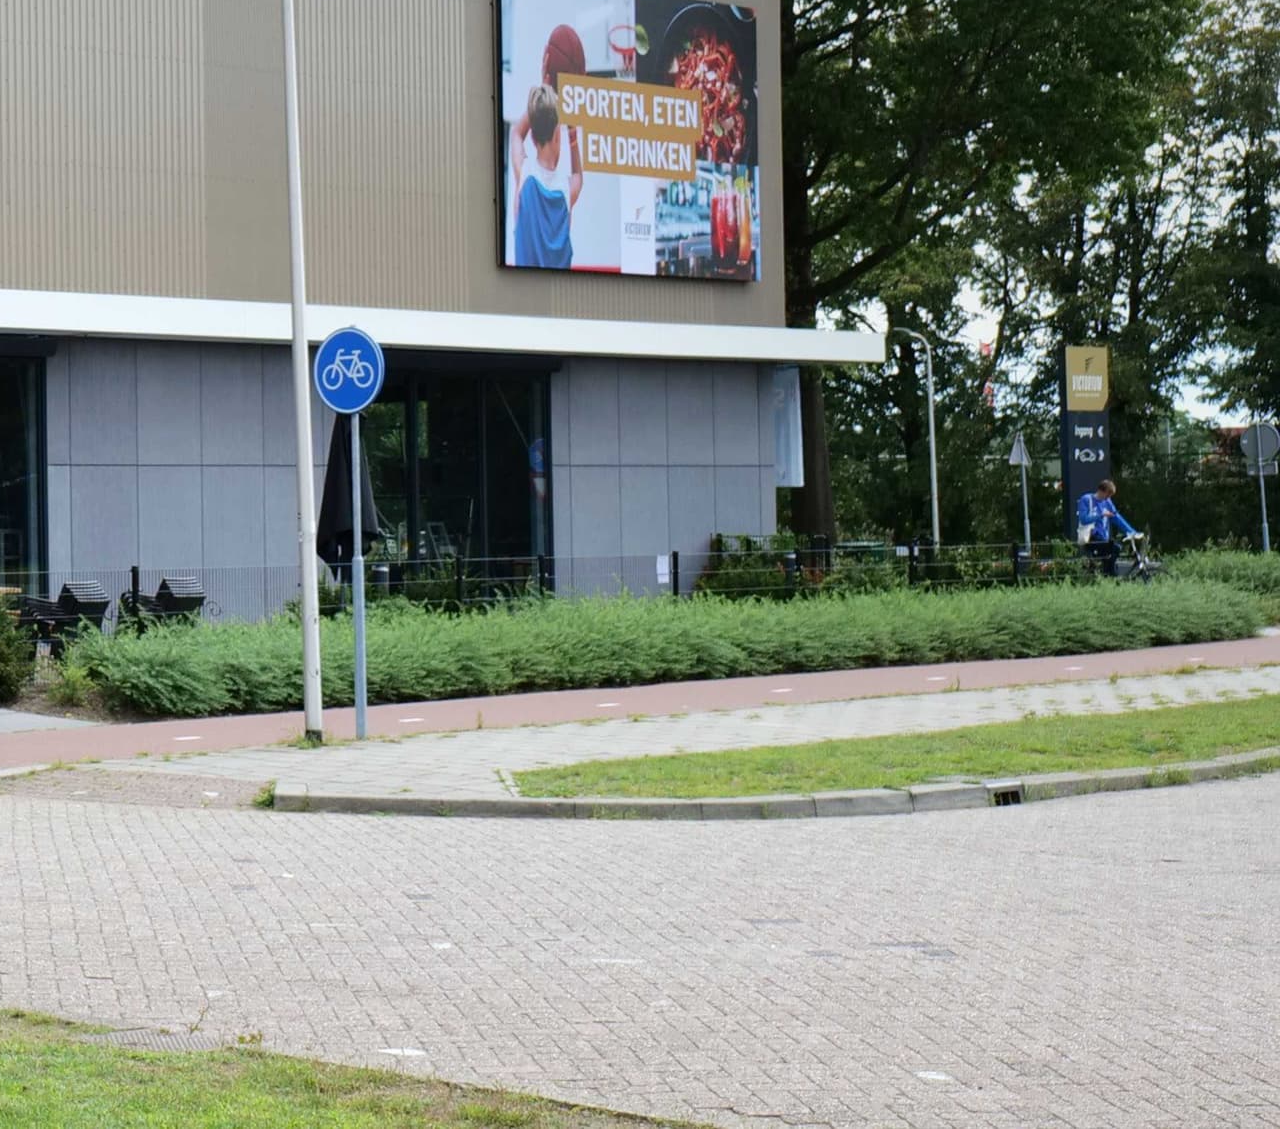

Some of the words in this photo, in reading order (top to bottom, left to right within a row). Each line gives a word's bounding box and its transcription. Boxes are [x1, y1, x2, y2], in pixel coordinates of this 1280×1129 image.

[562, 84, 648, 128] SPORTEN,
[653, 95, 698, 129] ETEN
[587, 132, 613, 165] EN
[615, 135, 692, 172] DRINKEN
